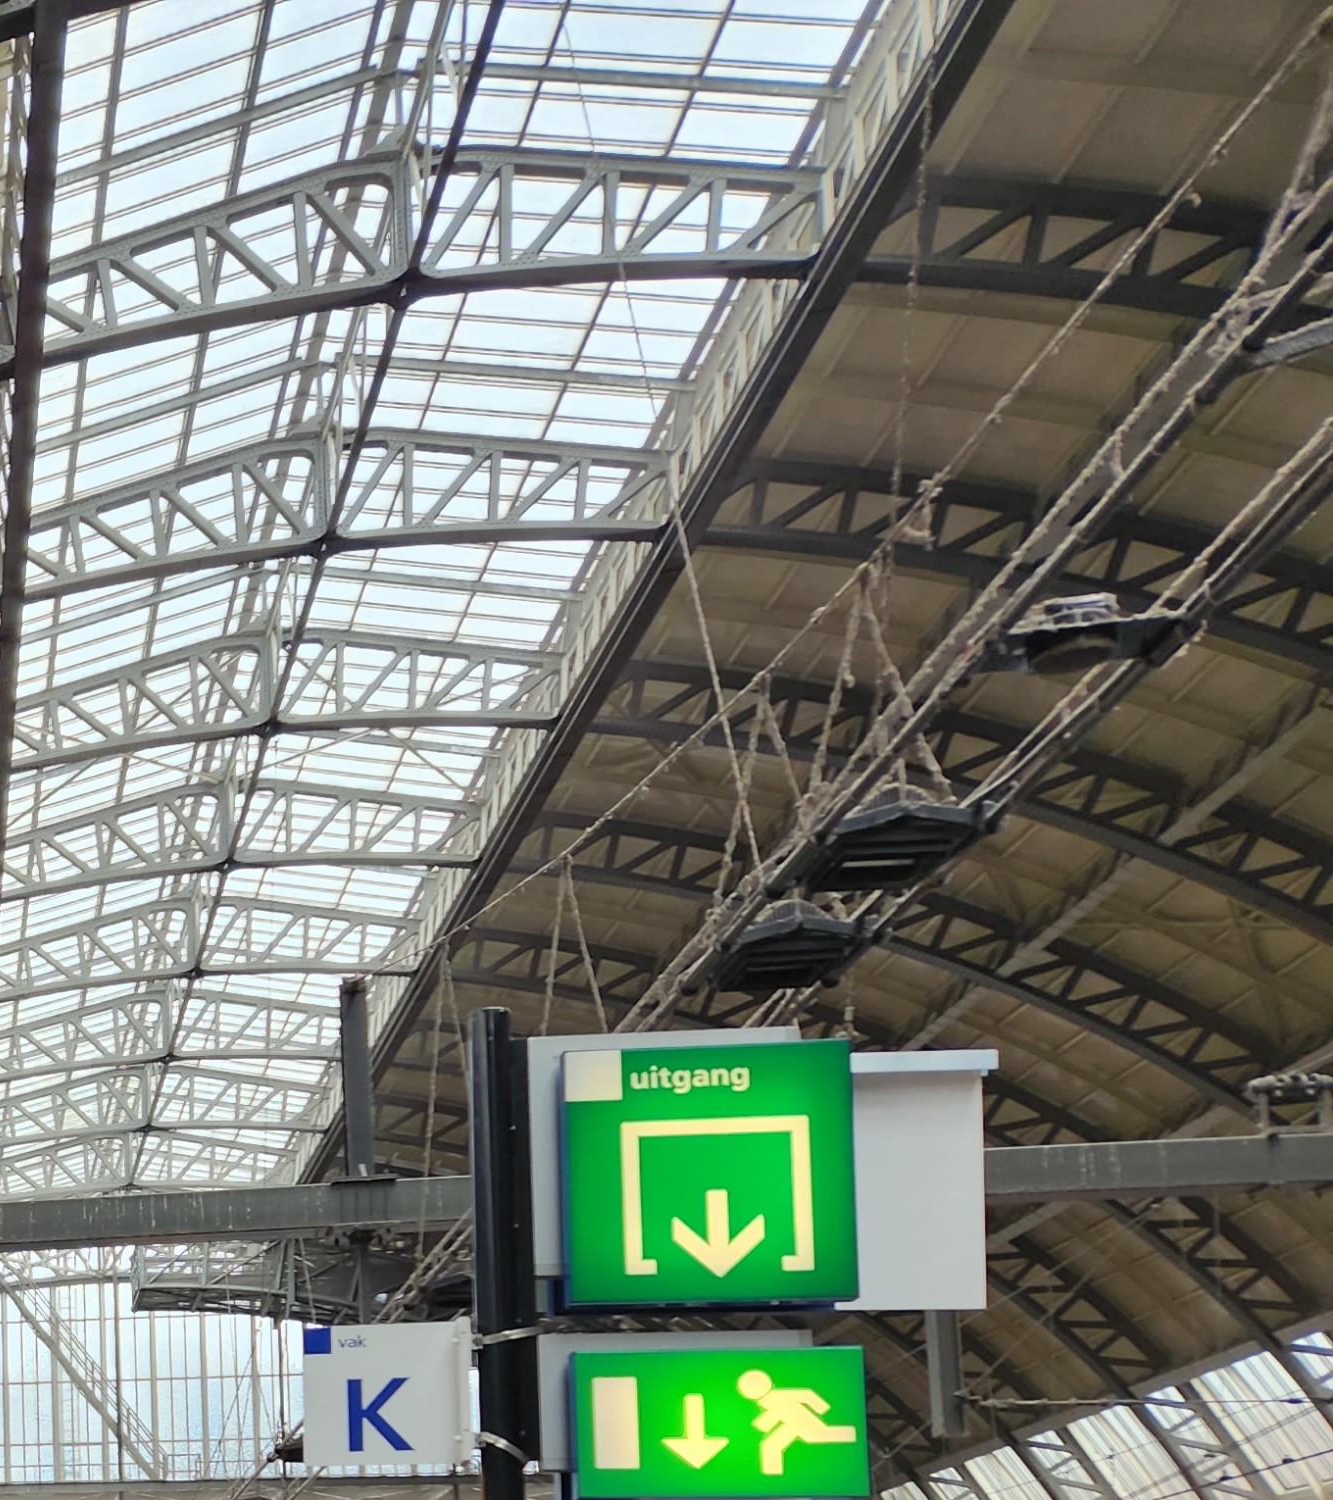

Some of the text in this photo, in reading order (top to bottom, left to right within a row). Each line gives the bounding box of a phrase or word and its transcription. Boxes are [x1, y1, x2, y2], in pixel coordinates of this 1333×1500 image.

[630, 1065, 750, 1094] uitgang
[338, 1335, 367, 1348] vak
[347, 1377, 414, 1452] K
